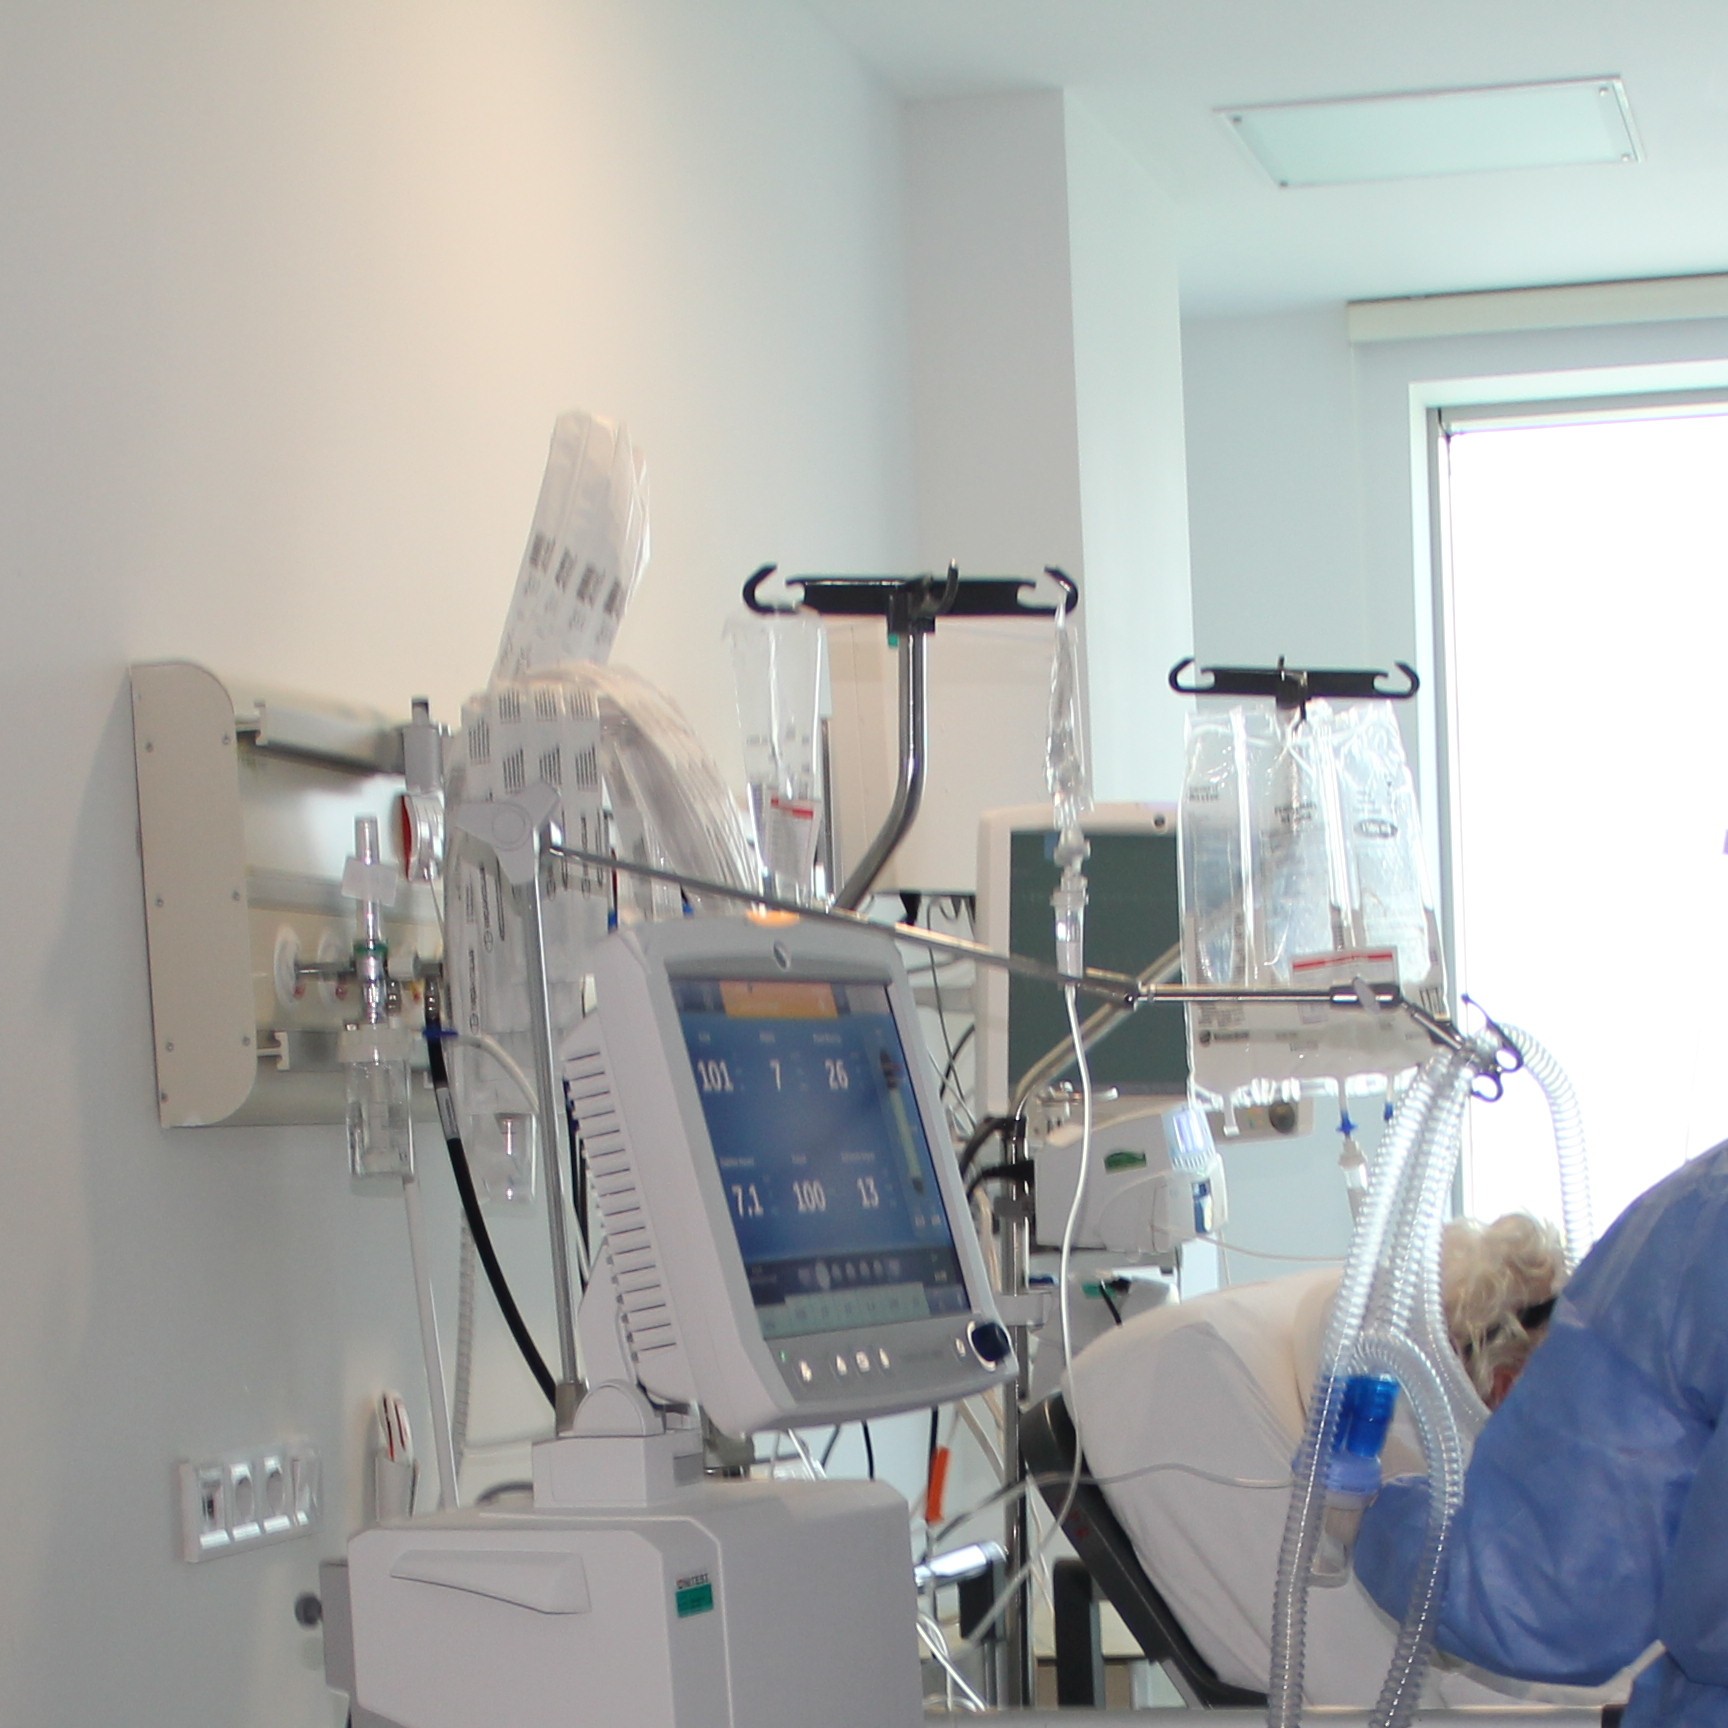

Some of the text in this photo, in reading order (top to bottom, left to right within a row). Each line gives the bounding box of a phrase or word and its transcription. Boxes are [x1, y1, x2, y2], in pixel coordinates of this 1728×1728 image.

[697, 1059, 734, 1091] 101
[769, 1059, 782, 1092] 7
[824, 1059, 849, 1090] 26
[792, 1179, 827, 1213] 100
